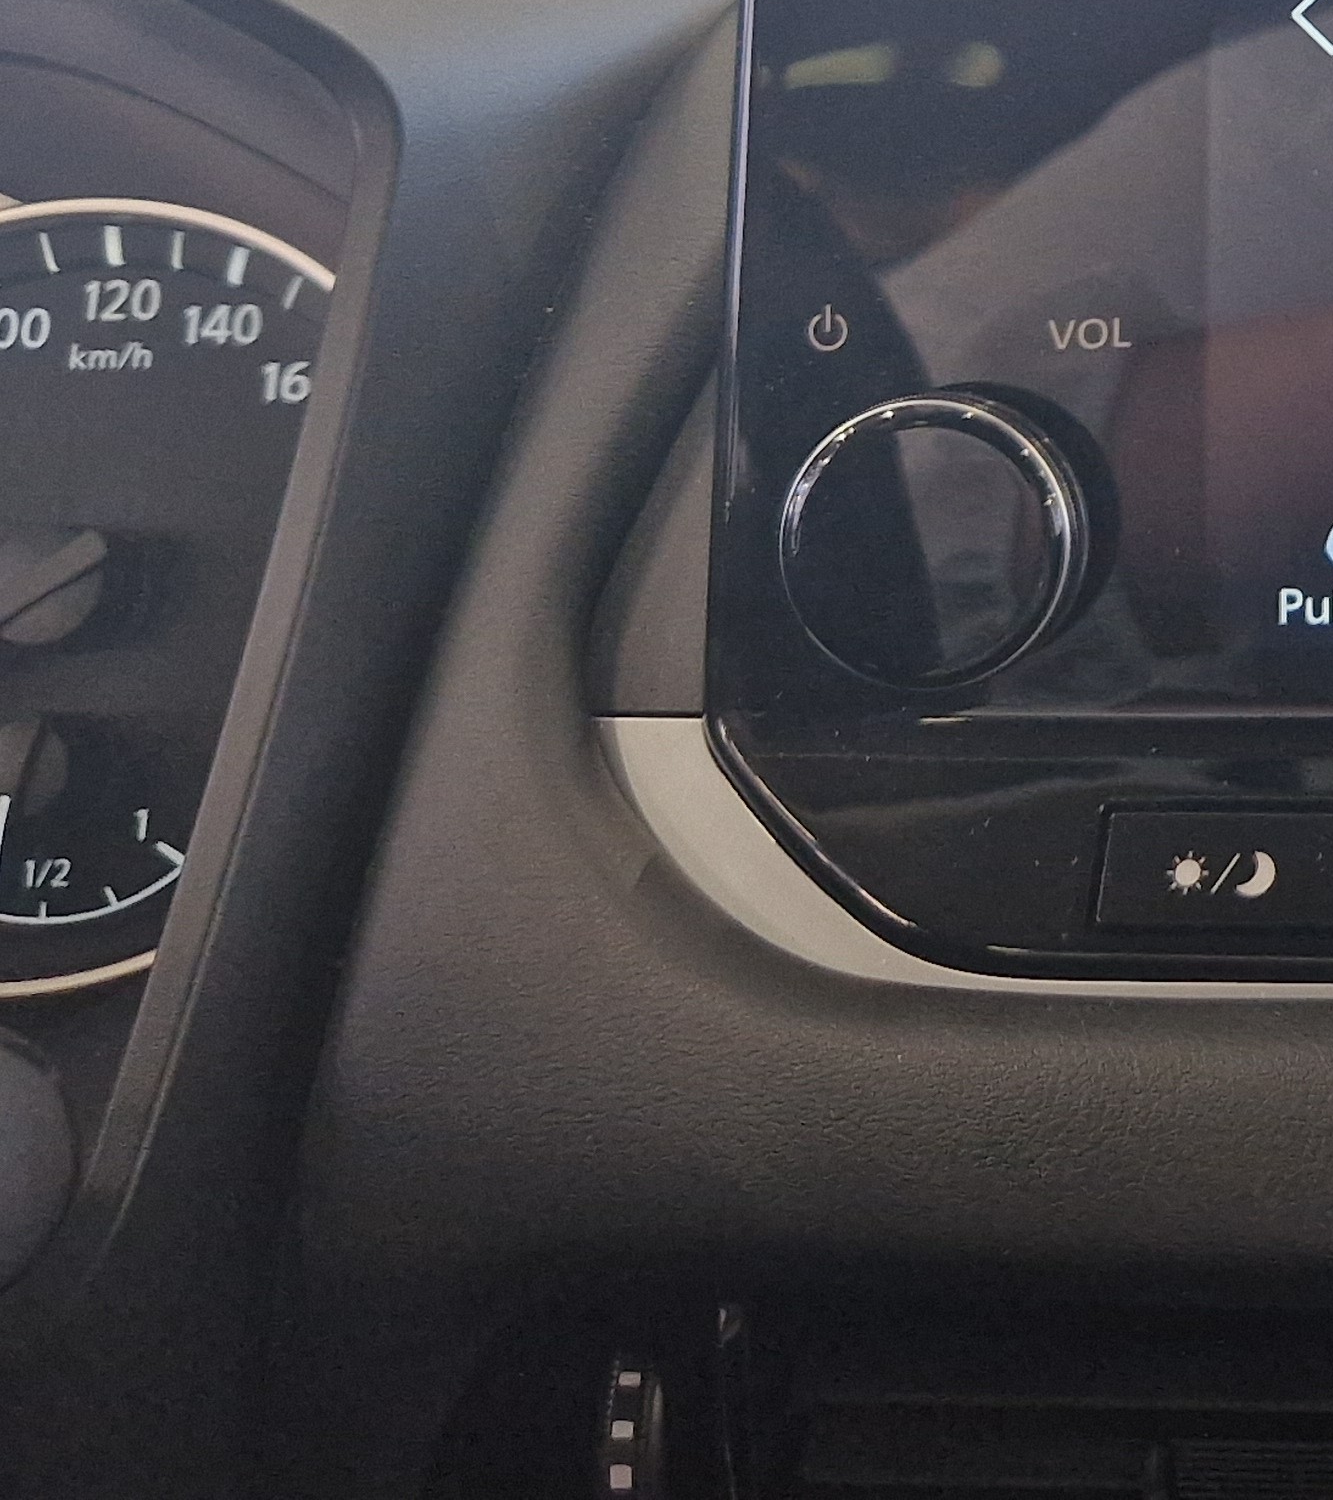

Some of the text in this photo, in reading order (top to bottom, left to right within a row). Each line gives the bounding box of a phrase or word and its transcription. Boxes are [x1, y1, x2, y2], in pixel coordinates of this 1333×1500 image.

[84, 278, 162, 322] 120
[183, 303, 263, 346] 140
[1048, 316, 1133, 351] VOL
[68, 342, 154, 372] km/h
[133, 807, 150, 843] 1
[24, 857, 73, 889] 1/2
